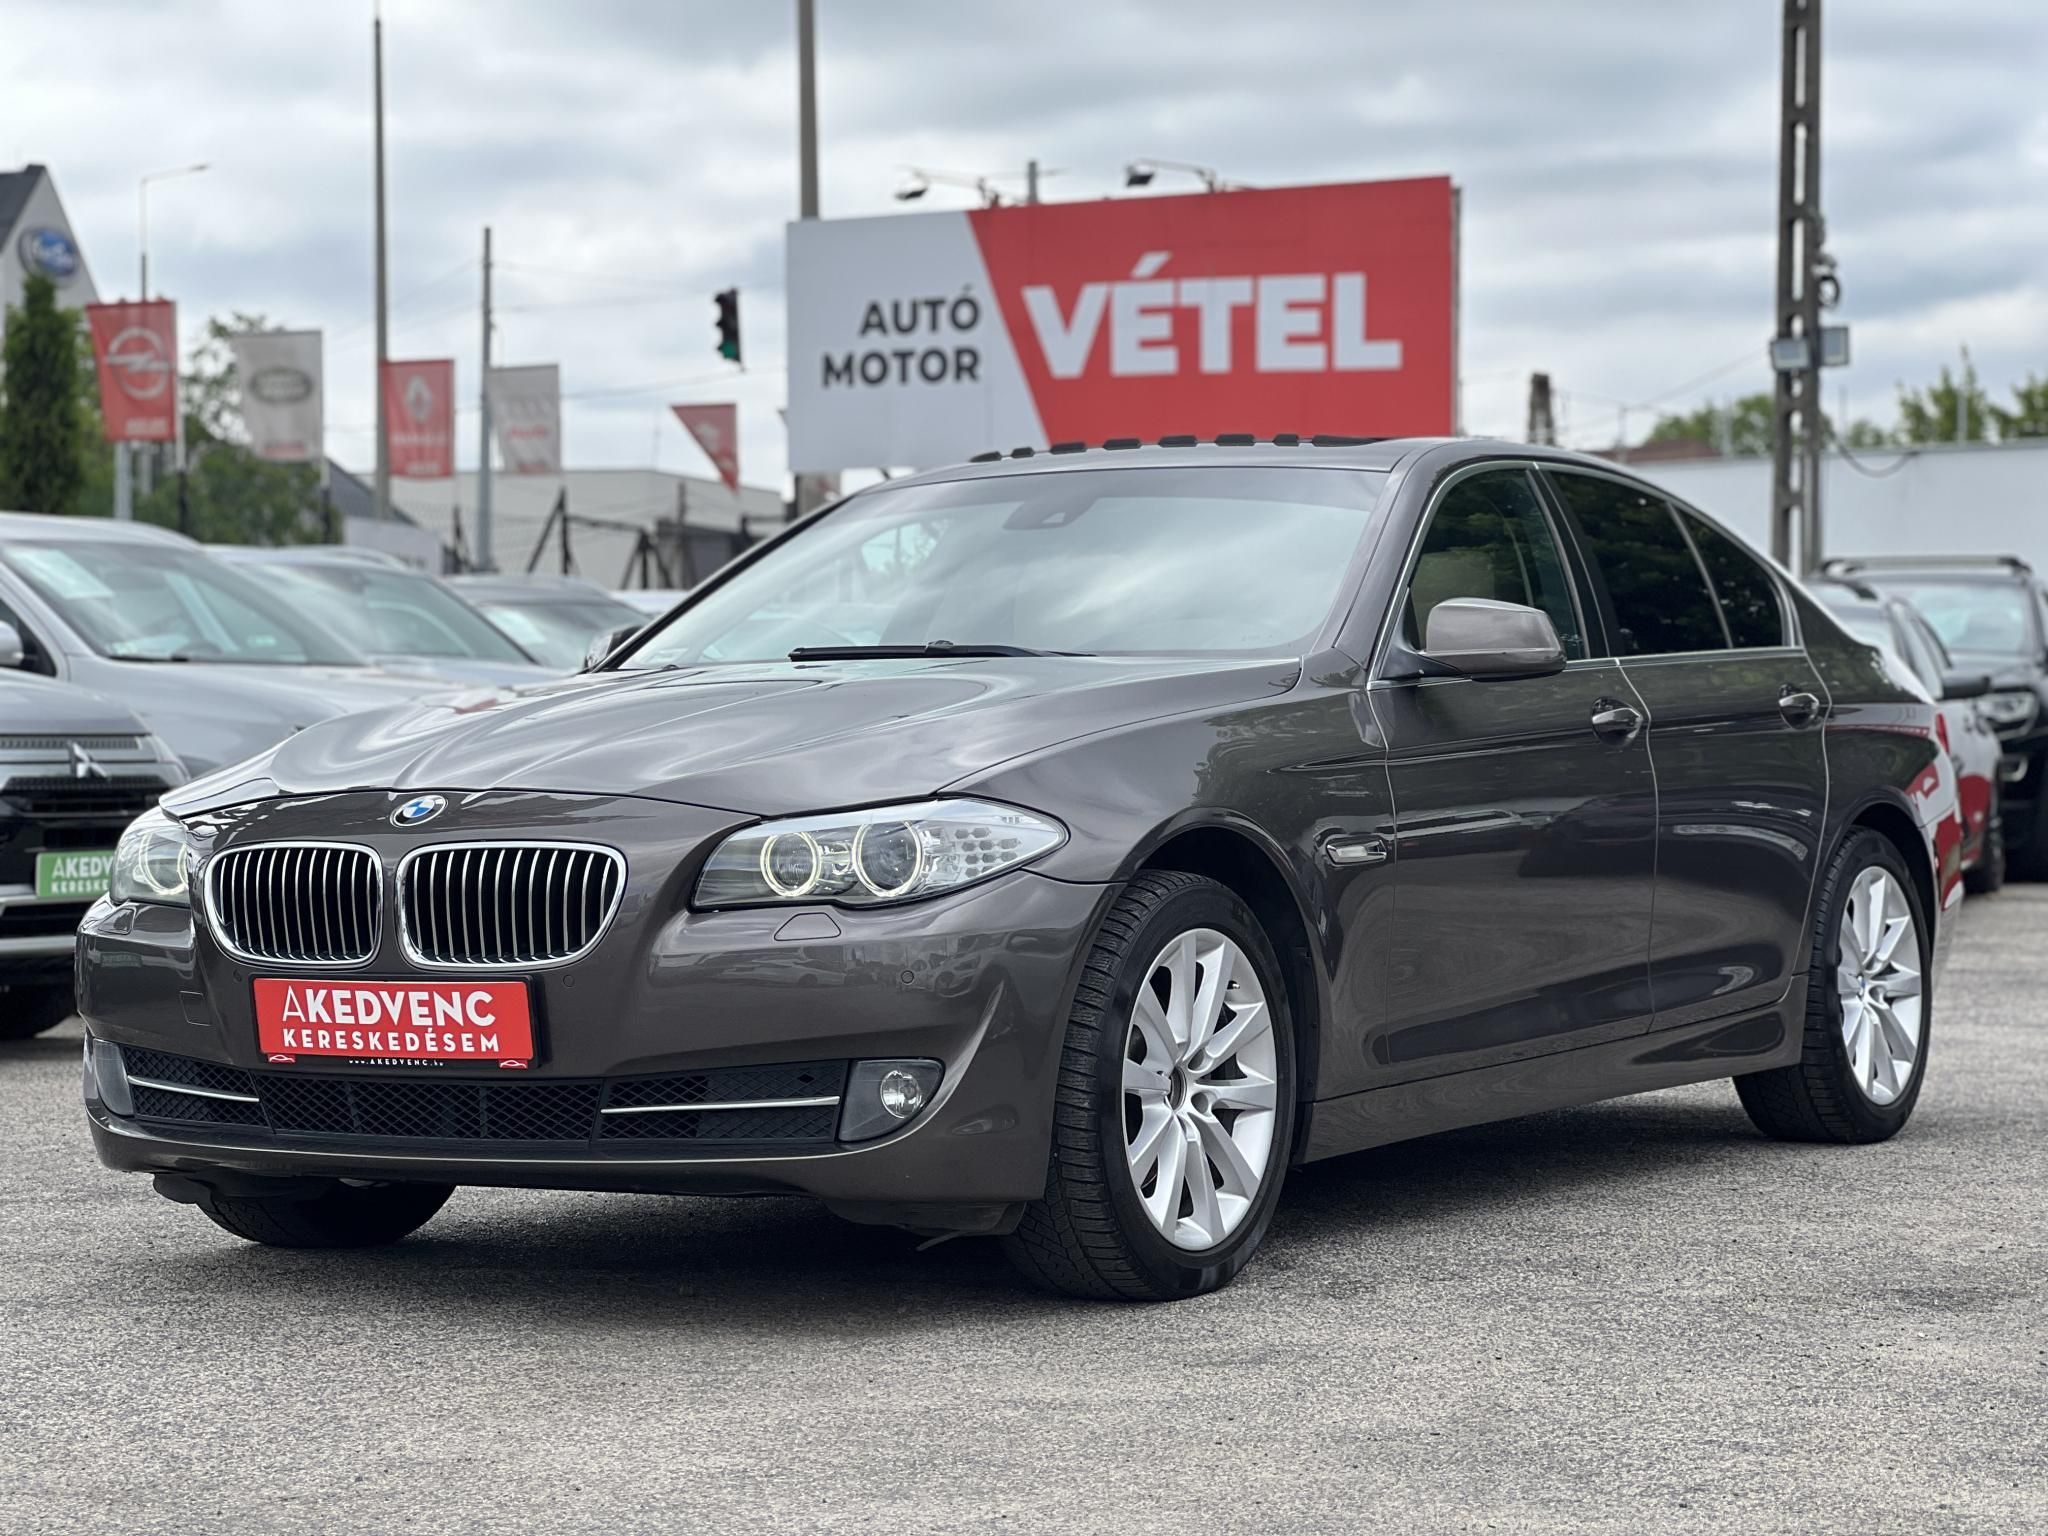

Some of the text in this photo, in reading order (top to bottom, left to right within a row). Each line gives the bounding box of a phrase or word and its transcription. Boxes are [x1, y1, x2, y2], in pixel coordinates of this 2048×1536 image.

[859, 284, 982, 338] AUTÓ
[1020, 251, 1403, 380] VÉTEL
[822, 347, 981, 389] MOTOR
[282, 985, 497, 1027] AKEDVENC
[283, 1027, 500, 1053] KERESKEDÉSEM
